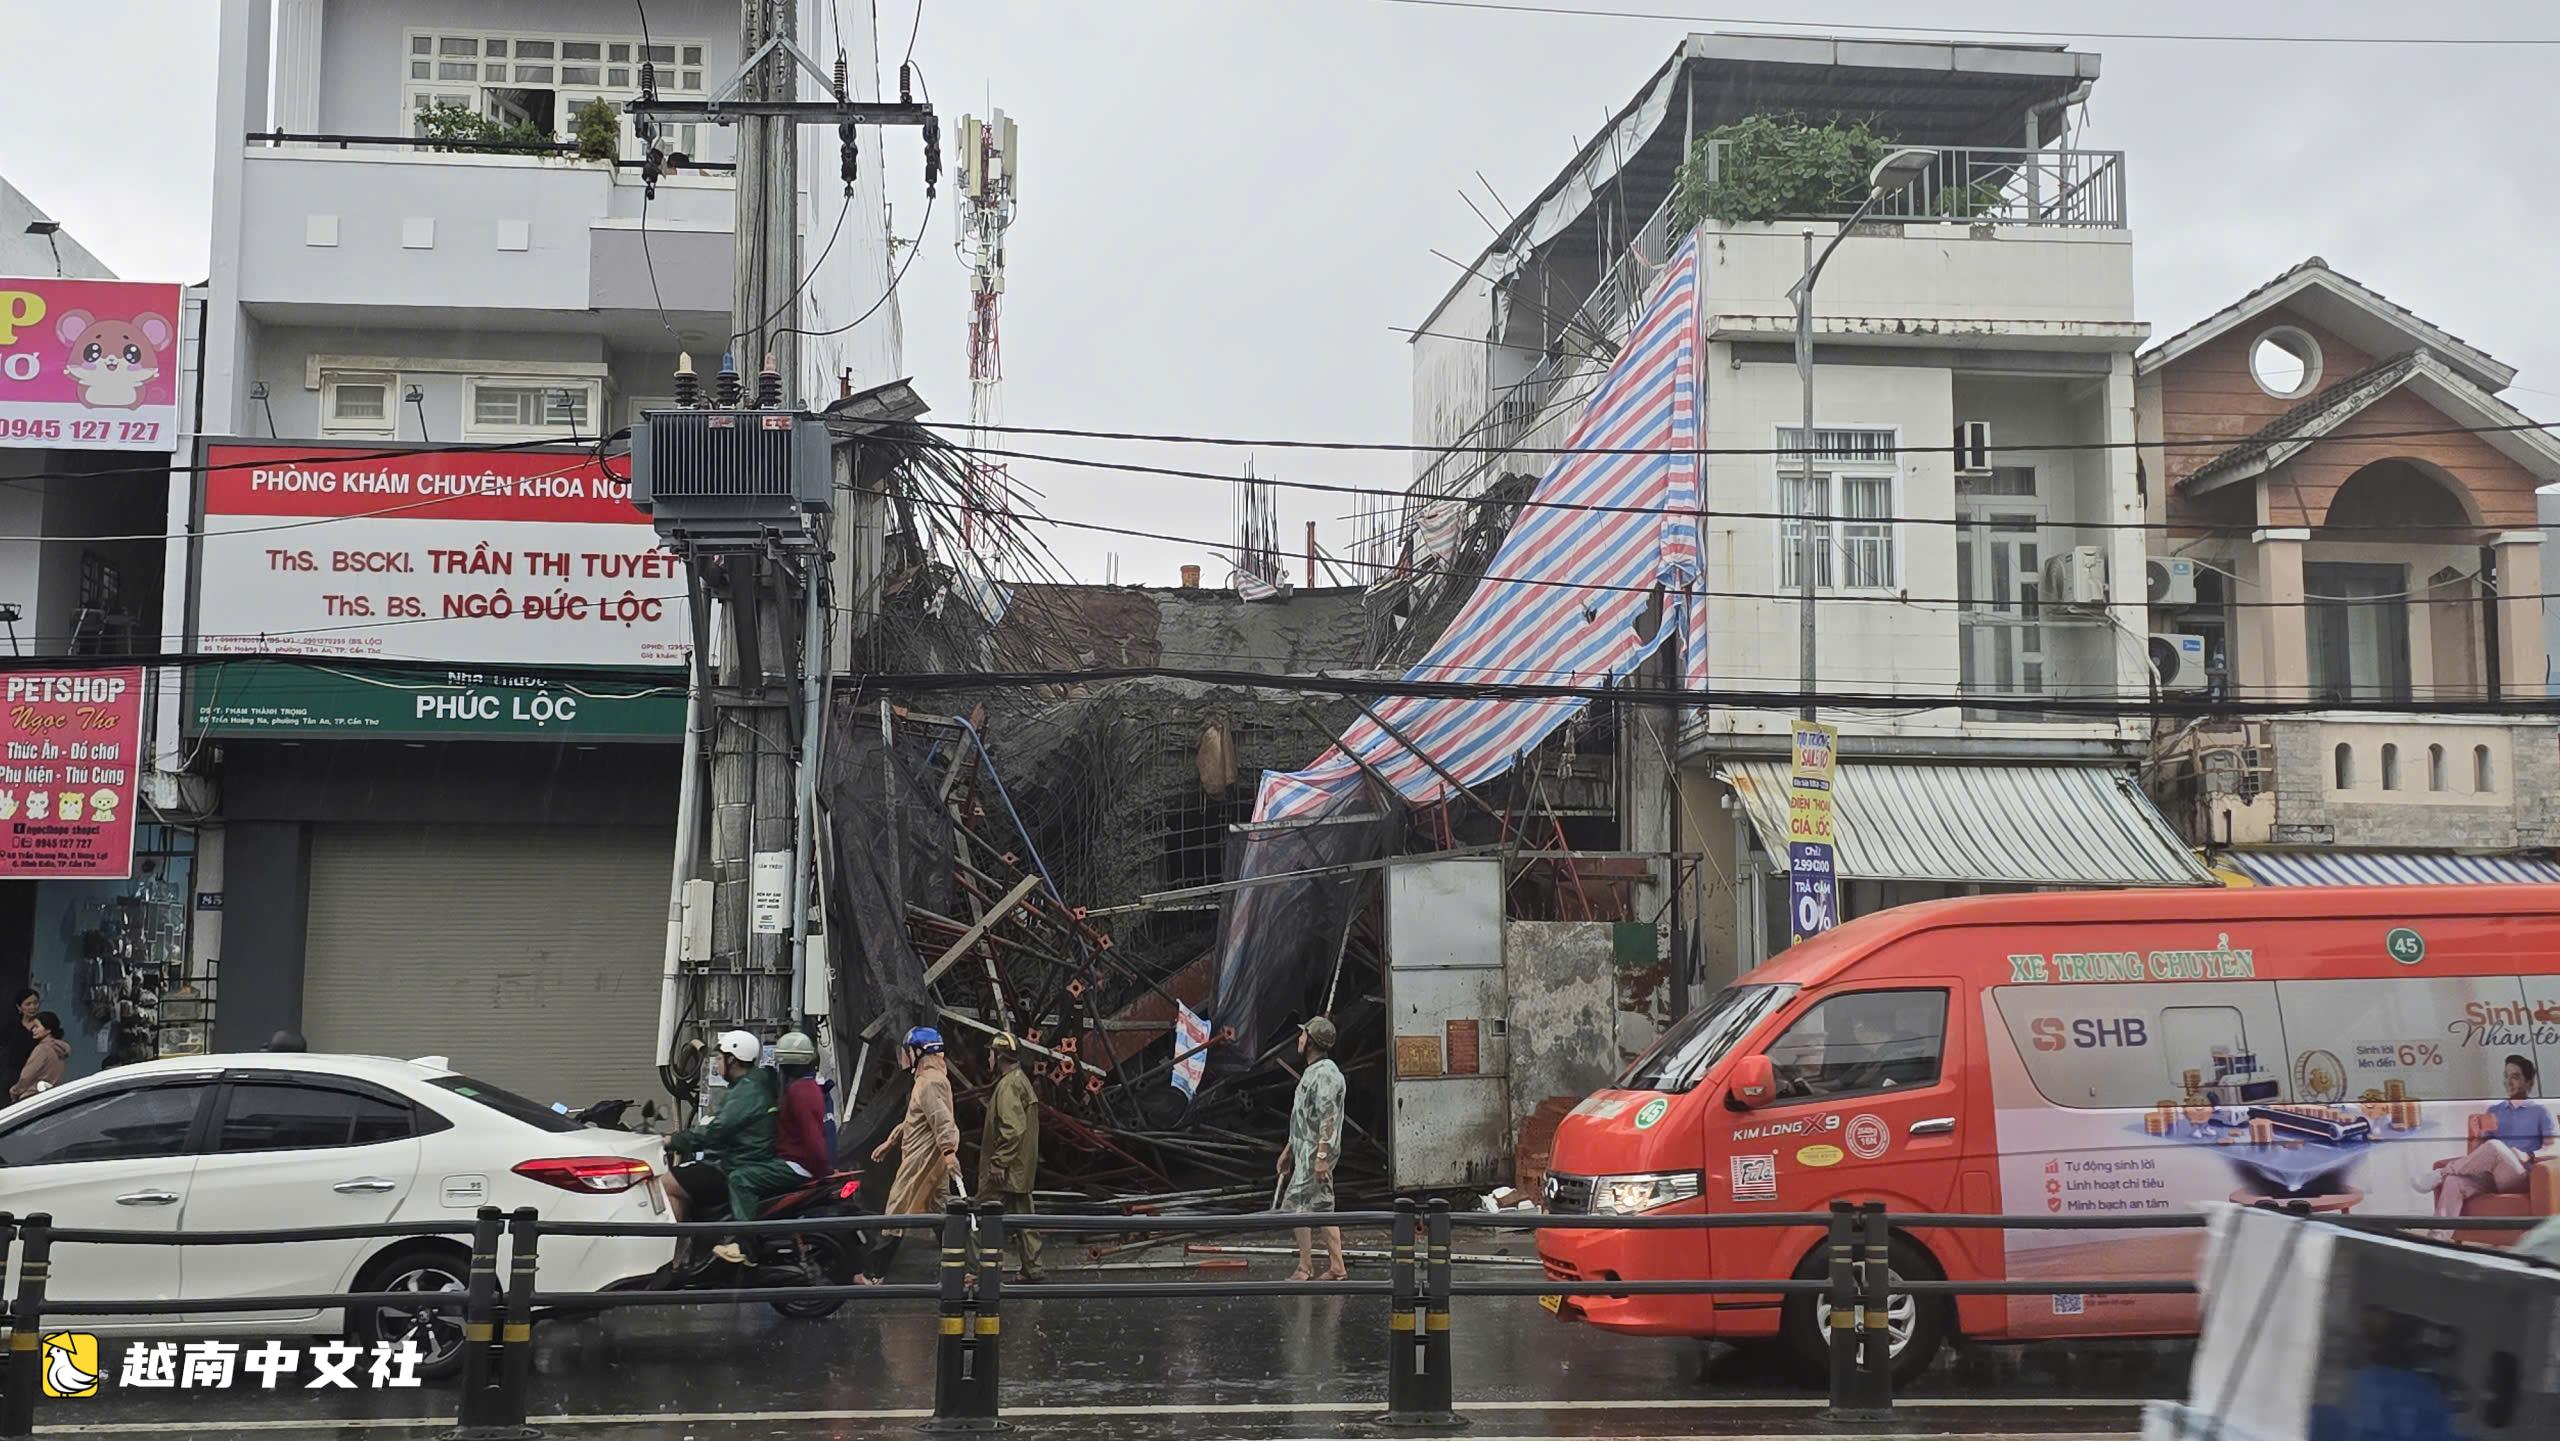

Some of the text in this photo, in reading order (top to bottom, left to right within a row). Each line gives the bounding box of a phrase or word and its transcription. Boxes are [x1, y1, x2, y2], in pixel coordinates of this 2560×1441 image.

[70, 421, 111, 440] 127
[118, 422, 160, 442] 727
[251, 464, 337, 493] PHÒNG
[343, 467, 410, 494] KHÁM
[417, 470, 512, 497] CHUYÊN
[519, 475, 584, 498] KHOA
[265, 541, 679, 583] ThS. BSCKI. TRẦN THỊ TUYẾT
[322, 587, 662, 628] ThS. BS. NGÔ ĐỨC LỘC
[7, 677, 126, 703] PETSHOP
[10, 705, 120, 735] Ngọc Thơ
[416, 690, 577, 726] PHÚC LỘC
[7, 740, 38, 760] Thức
[41, 739, 59, 760] Ăn
[91, 742, 119, 760] chơi
[0, 765, 21, 788] Phụ
[25, 764, 53, 788] kiện
[66, 765, 89, 784] Thú
[92, 765, 125, 786] Cưng
[1792, 814, 1812, 835] GIÁ
[60, 839, 74, 849] 127
[76, 839, 93, 849] 727
[1798, 895, 1832, 931] 0%
[2007, 932, 2256, 983] XE TRUNG CHUYỂN
[2394, 937, 2419, 954] 45
[2465, 1000, 2532, 1027] Sinh
[2072, 1017, 2148, 1048] SHB
[2448, 1019, 2529, 1048] Nhàn
[2398, 1043, 2443, 1067] 6%
[1733, 1128, 1759, 1141] KIM
[1762, 1121, 1803, 1137] LONG
[1801, 1112, 1840, 1136] X9
[2065, 1159, 2155, 1173] Tự động sinh lời
[2067, 1177, 2165, 1191] Linh hoạt chi tiêu
[2067, 1198, 2170, 1211] Minh bạch an tâm
